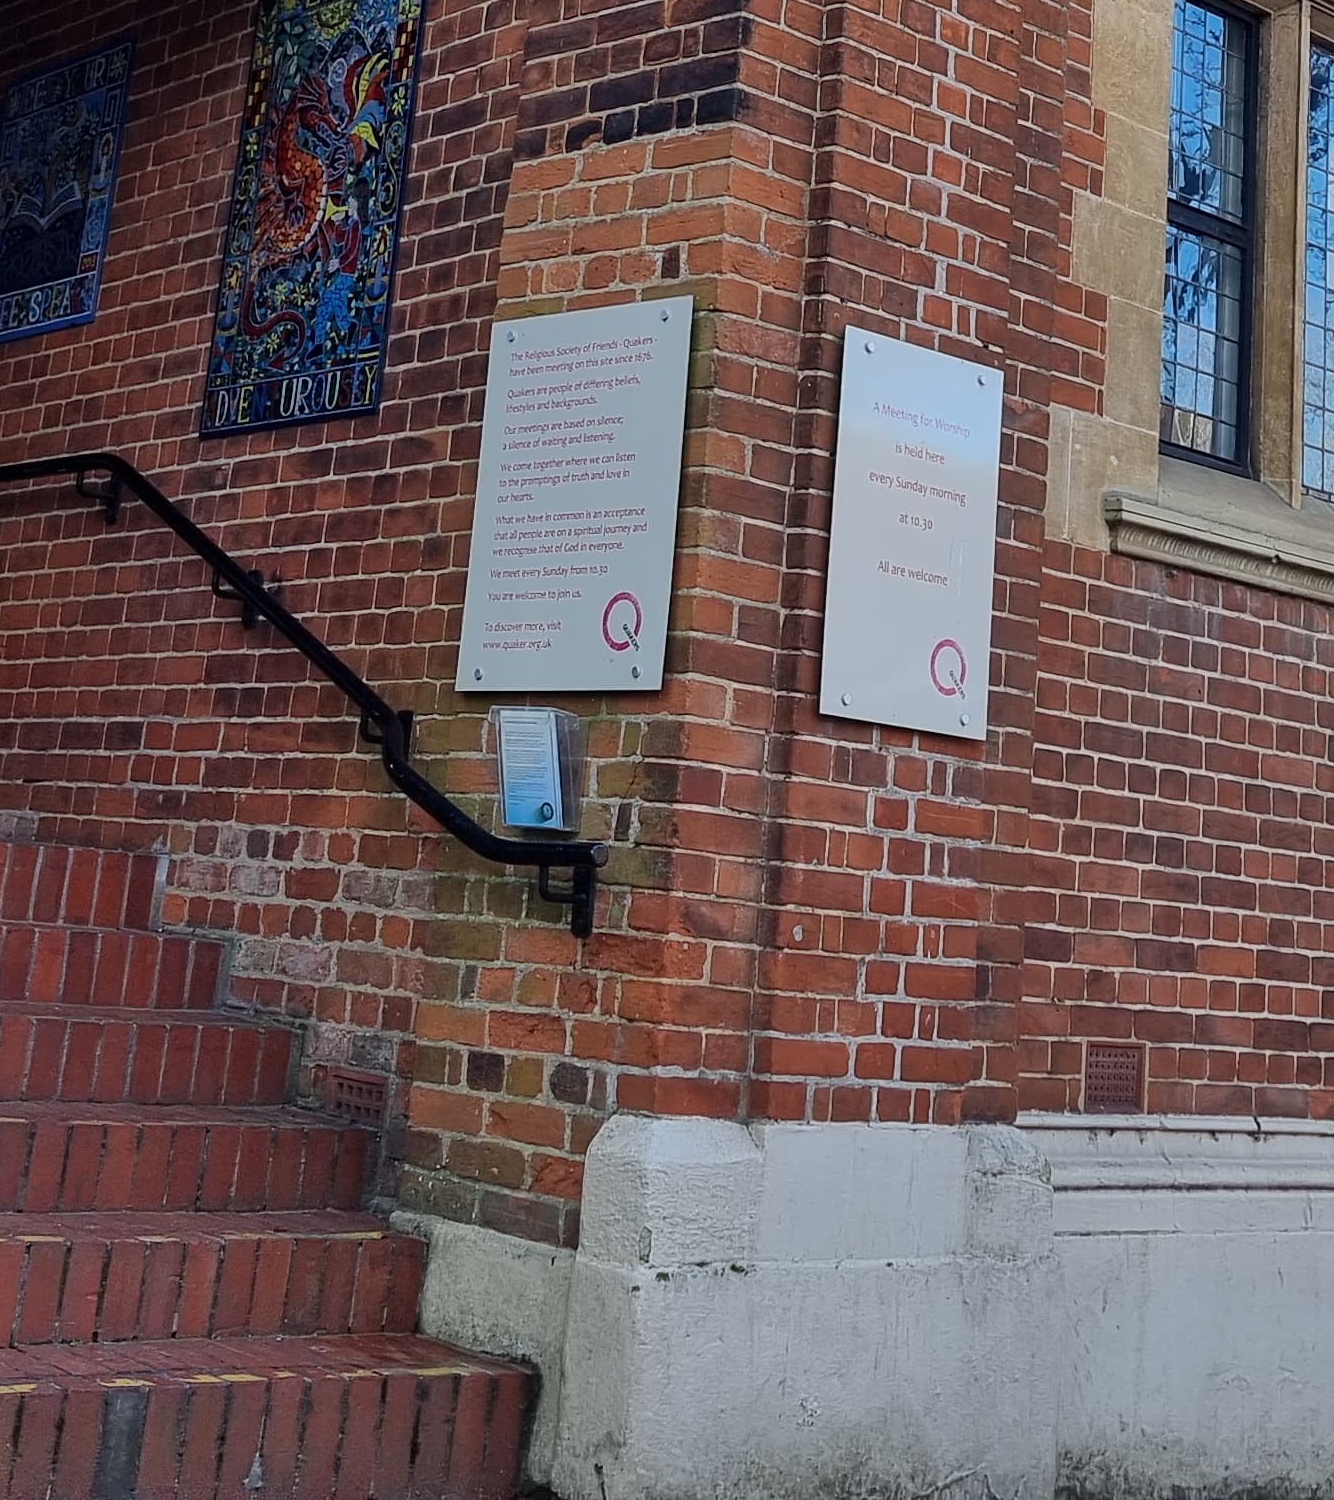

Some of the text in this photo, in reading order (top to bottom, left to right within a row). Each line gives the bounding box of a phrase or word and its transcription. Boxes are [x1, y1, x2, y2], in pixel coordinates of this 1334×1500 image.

[65, 58, 106, 98] YUR
[511, 352, 523, 362] The
[524, 348, 555, 361] Religious
[556, 344, 581, 357] Society
[583, 340, 592, 352] of
[592, 340, 617, 352] Friends
[623, 336, 653, 349] Quakers
[509, 366, 525, 377] have
[526, 364, 545, 375] been
[545, 361, 574, 373] meeting
[576, 360, 584, 368] on
[586, 357, 600, 367] this
[600, 356, 613, 365] site
[615, 354, 633, 363] since
[207, 363, 378, 428] DVENUROUSLY
[507, 388, 536, 399] Quakers
[537, 386, 548, 395] are
[548, 382, 573, 396] people
[574, 380, 582, 390] of
[583, 378, 614, 390] differing
[506, 401, 536, 413] lifestyles
[537, 399, 550, 410] and
[504, 425, 518, 435] Our
[518, 422, 550, 434] meetings
[550, 421, 562, 430] are
[563, 418, 585, 429] based
[586, 418, 596, 428] on
[873, 401, 971, 438] A Meeting for Worship
[502, 442, 507, 450] a
[508, 439, 532, 450] silence
[532, 437, 540, 448] of
[541, 435, 567, 447] waiting
[568, 433, 582, 444] and
[500, 463, 512, 472] We
[533, 459, 565, 471] together
[565, 456, 588, 466] where
[589, 456, 600, 464] we
[601, 455, 614, 463] can
[616, 452, 636, 462] listen
[895, 443, 945, 465] is held here
[499, 468, 630, 488] to the promptings of truth and love in
[497, 495, 510, 503] our
[869, 471, 966, 508] every Sunday morning
[495, 515, 514, 525] What
[527, 513, 543, 523] have
[545, 512, 552, 521] in
[553, 511, 585, 522] common
[586, 509, 592, 519] is
[593, 510, 602, 519] an
[603, 507, 646, 519] acceptance
[899, 513, 933, 531] at 10.30
[494, 530, 509, 541] that
[509, 529, 518, 540] all
[519, 528, 543, 541] people
[543, 529, 556, 537] are
[556, 528, 567, 537] on
[573, 524, 603, 538] spiritual
[603, 523, 631, 536] journey
[632, 522, 647, 532] and
[492, 548, 504, 557] we
[504, 546, 537, 558] recognise
[538, 543, 554, 554] that
[554, 542, 563, 553] of
[564, 542, 579, 552] God
[580, 541, 588, 551] in
[490, 569, 502, 579] We
[502, 569, 520, 578] meet
[522, 569, 541, 579] every
[541, 566, 568, 578] Sunday
[570, 565, 588, 575] from
[877, 560, 948, 587] All are welcome
[488, 592, 501, 602] You
[502, 591, 514, 601] are
[515, 591, 547, 600] welcome
[548, 590, 557, 599] to
[556, 589, 571, 600] join
[485, 622, 493, 632] To
[494, 621, 523, 632] discover
[546, 620, 561, 631] visit
